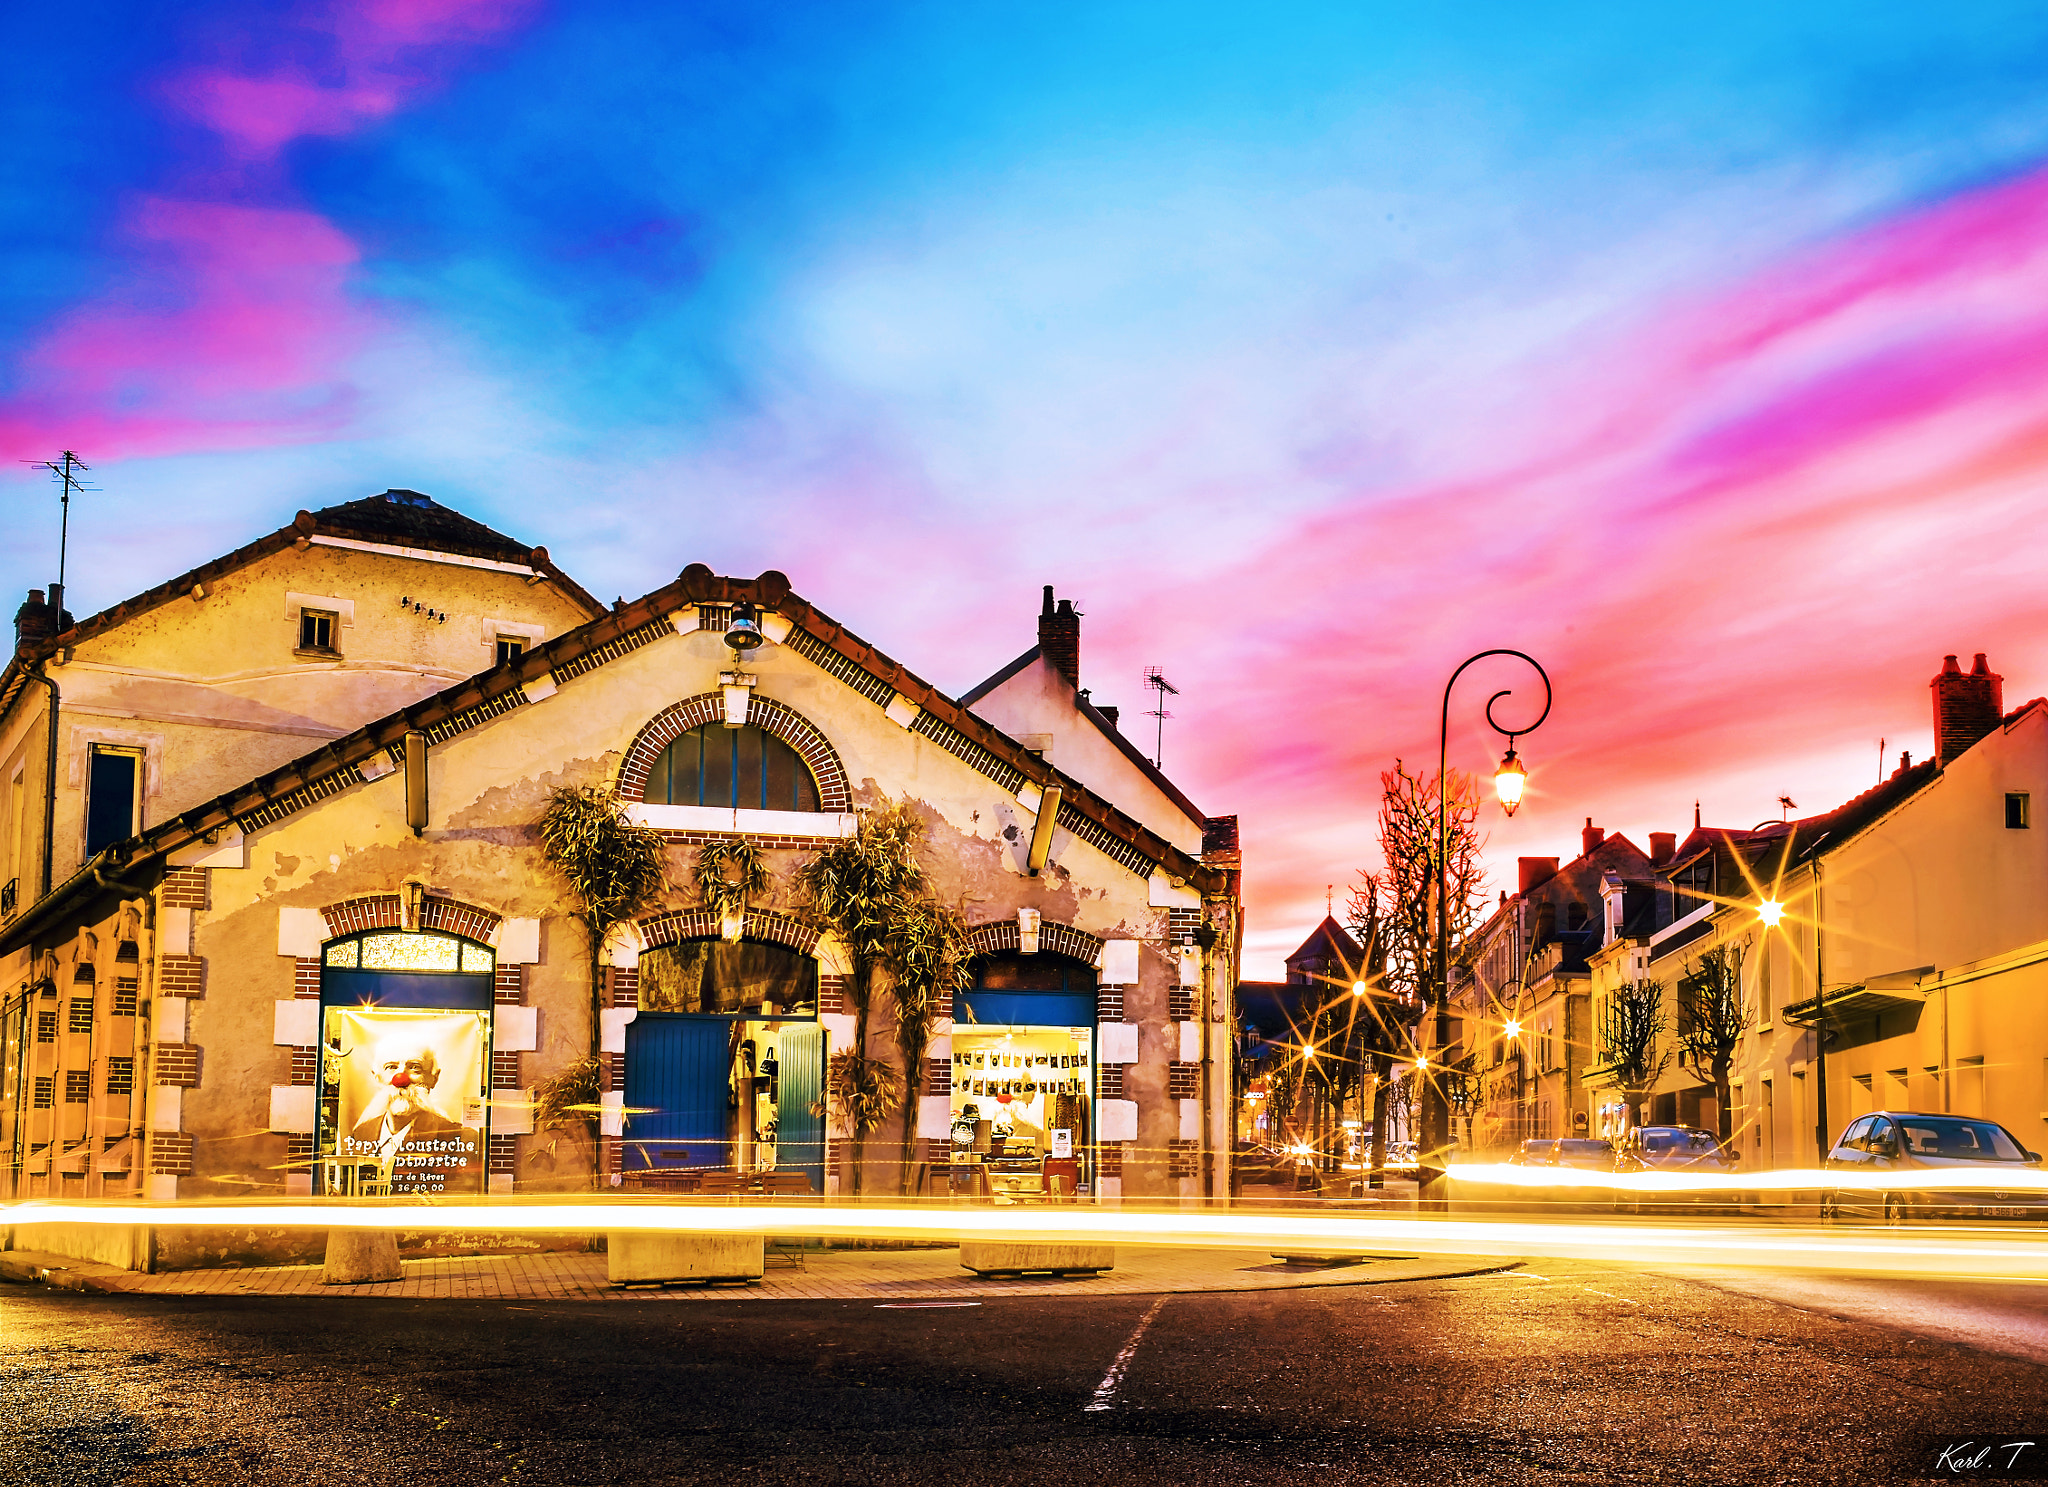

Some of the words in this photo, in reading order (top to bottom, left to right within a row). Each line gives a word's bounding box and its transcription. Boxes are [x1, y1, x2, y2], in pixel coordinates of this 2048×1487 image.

[344, 1135, 381, 1154] Papy
[380, 1154, 468, 1168] ntmartre
[406, 1172, 417, 1181] de
[431, 1183, 445, 1192] 00
